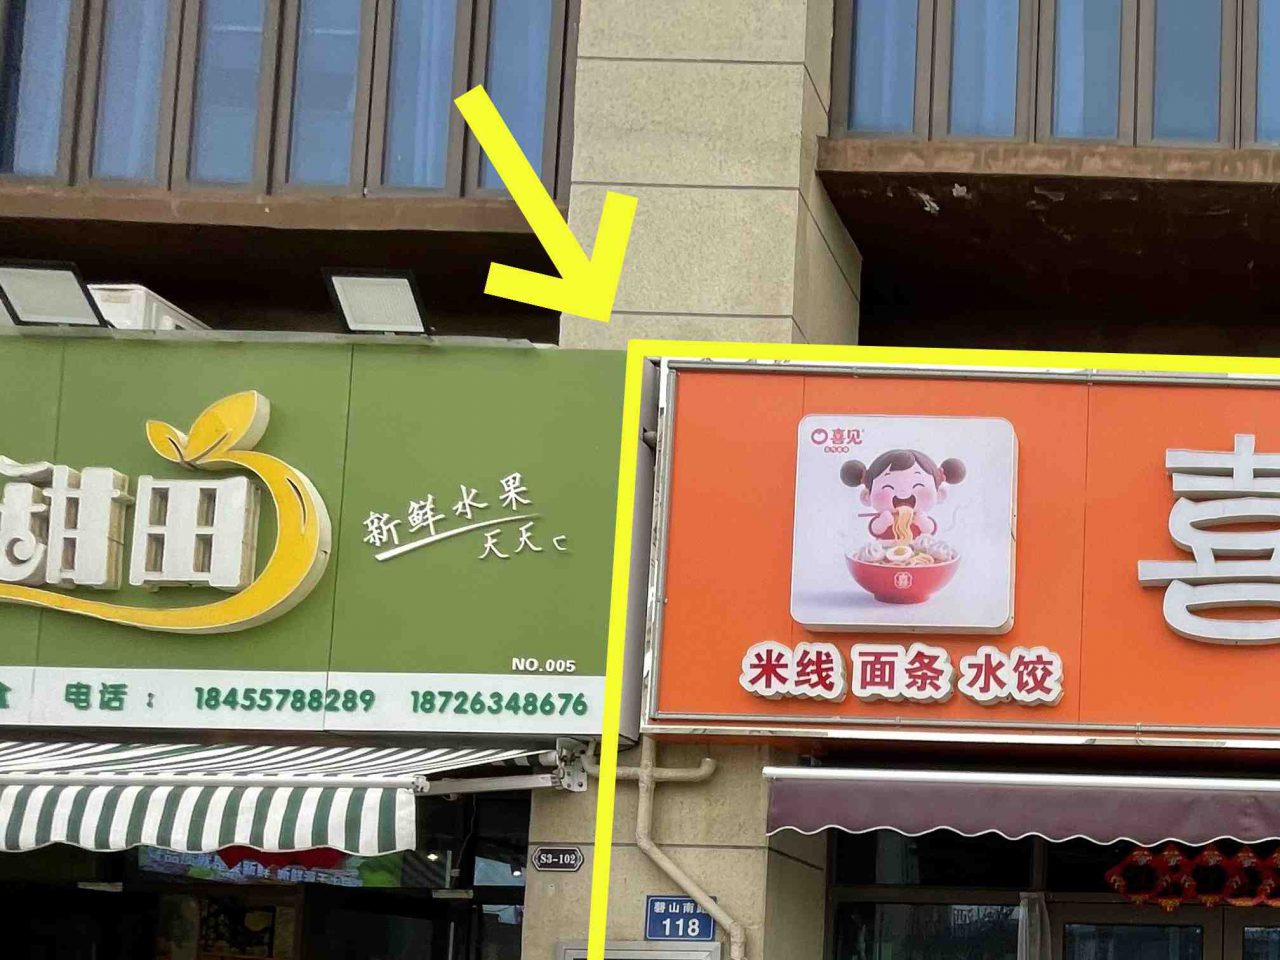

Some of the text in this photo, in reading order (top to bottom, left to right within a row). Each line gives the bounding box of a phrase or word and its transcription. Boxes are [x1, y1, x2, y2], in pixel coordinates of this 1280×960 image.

[363, 472, 533, 547] 新鲜水果
[511, 657, 576, 673] NO.005
[746, 647, 1059, 700] 米线 面条 水饺
[194, 687, 376, 713] 18455788289
[410, 691, 588, 716] 18726348676
[539, 853, 576, 864] S3-102
[662, 918, 700, 936] 118
